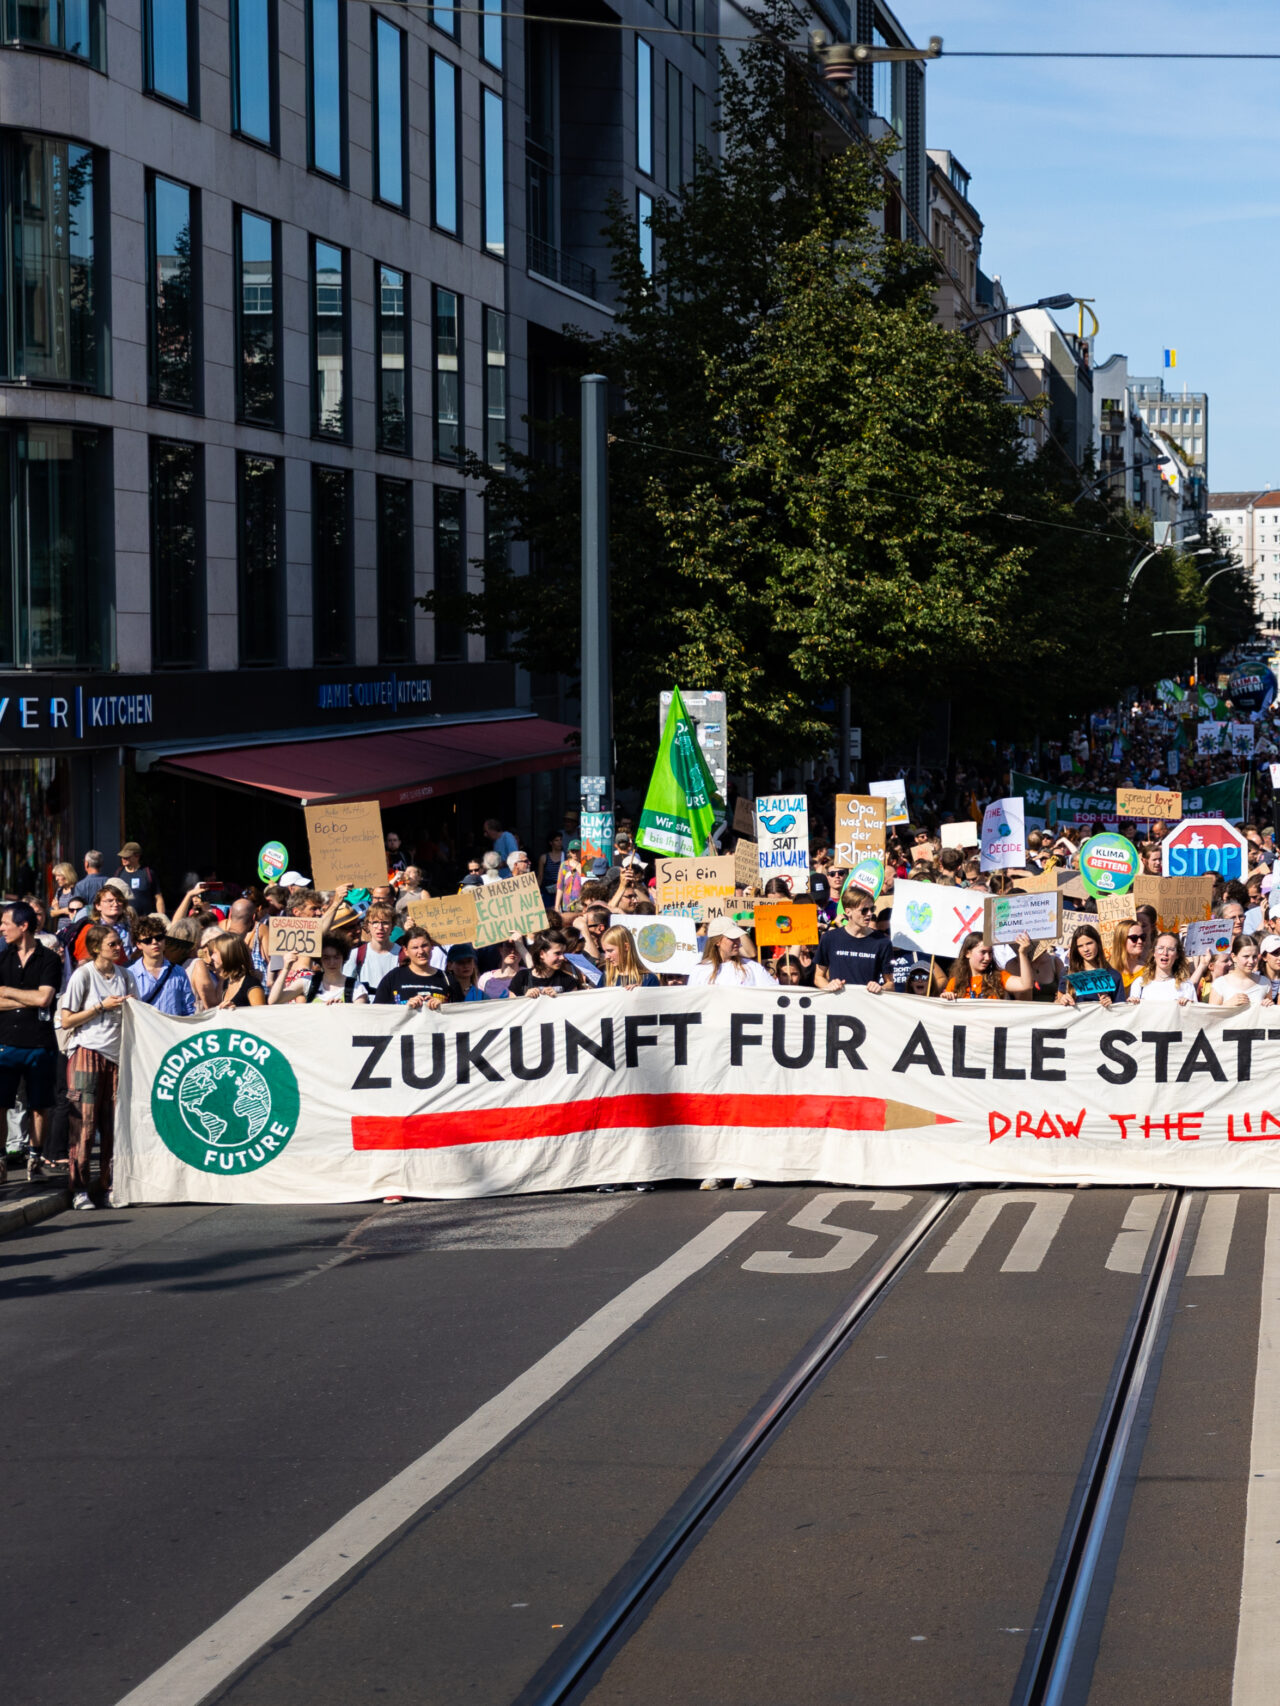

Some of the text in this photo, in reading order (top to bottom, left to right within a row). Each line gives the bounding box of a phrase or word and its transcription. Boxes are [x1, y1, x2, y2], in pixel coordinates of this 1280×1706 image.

[320, 683, 352, 709] JAMIE
[397, 679, 432, 703] KITCHEN
[91, 693, 152, 727] KITCHEN
[757, 798, 807, 813] BLAUWAL
[1124, 793, 1172, 807] spread love
[848, 799, 877, 820] Opa,
[1130, 805, 1145, 815] not
[314, 822, 348, 834] Bobo
[580, 815, 613, 827] KLIMA
[655, 815, 673, 829] Wir
[840, 819, 884, 830] was war
[580, 827, 613, 839] DEMO
[851, 829, 871, 841] der
[772, 836, 798, 851] STATT
[988, 843, 1022, 855] DECIDE
[759, 850, 809, 869] BLAUWAHL
[836, 842, 885, 864] Rhein?
[1095, 848, 1125, 859] KLIMA
[1170, 843, 1238, 876] STOP
[661, 862, 717, 884] Sei ein
[1090, 858, 1128, 873] RETTEN!
[857, 872, 876, 887] KLIMA
[1135, 877, 1206, 896] TOO HOT
[487, 880, 520, 897] HABEN
[475, 894, 514, 922] ECHT
[519, 890, 540, 912] AUF
[663, 899, 699, 911] rette die
[726, 899, 739, 910] EAT
[742, 900, 755, 910] THE
[1030, 899, 1050, 907] MEHR
[1100, 897, 1120, 911] THIS
[1122, 895, 1131, 908] IS
[1099, 908, 1135, 921] GETTING
[473, 911, 546, 948] ZUKUNFT
[275, 928, 316, 954] 2035
[1076, 974, 1116, 992] WE RISE
[351, 1011, 702, 1090] ZUKUNFT
[729, 996, 869, 1071] FÜR
[892, 1020, 1068, 1082] ALLE
[156, 1034, 271, 1101] FRIDAYS FOR
[987, 1107, 1087, 1144] DRAW
[1108, 1111, 1204, 1142] THE
[204, 1121, 290, 1170] FUTURE
